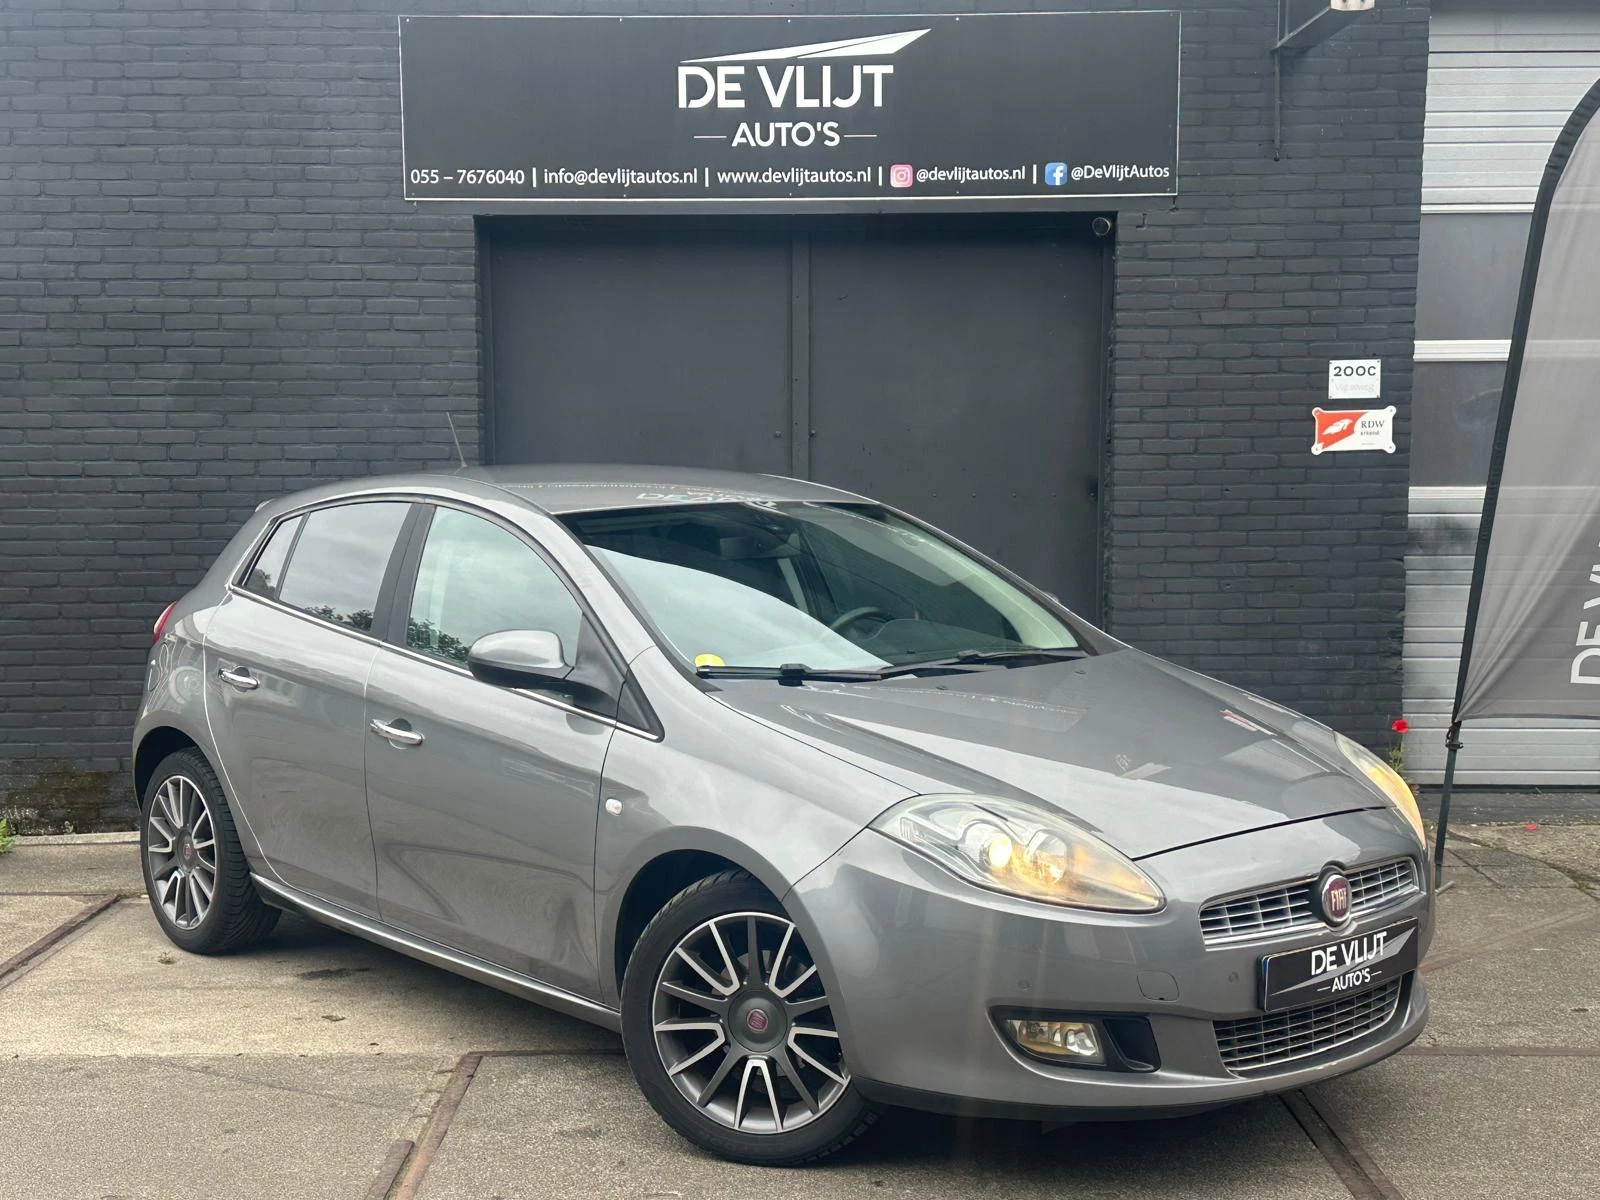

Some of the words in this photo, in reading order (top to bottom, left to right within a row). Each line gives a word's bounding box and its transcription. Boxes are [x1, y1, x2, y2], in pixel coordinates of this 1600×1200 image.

[677, 65, 746, 109] DE
[757, 64, 894, 108] VLIJT
[731, 121, 841, 148] AUTO'S
[410, 169, 440, 185] 055
[457, 169, 525, 185] 7676040
[543, 167, 698, 188] info@devlijtautos.nl
[717, 166, 872, 187] www.devlijtautos.nl
[916, 165, 1026, 184] @devlijtautos.nl
[1071, 163, 1170, 181] @DeVlijtAutos
[1361, 420, 1385, 429] RDW
[1331, 888, 1347, 911] FIAT
[1311, 946, 1338, 976] DE
[1341, 931, 1388, 966] VLIJT
[1331, 967, 1371, 993] AUTO'S
